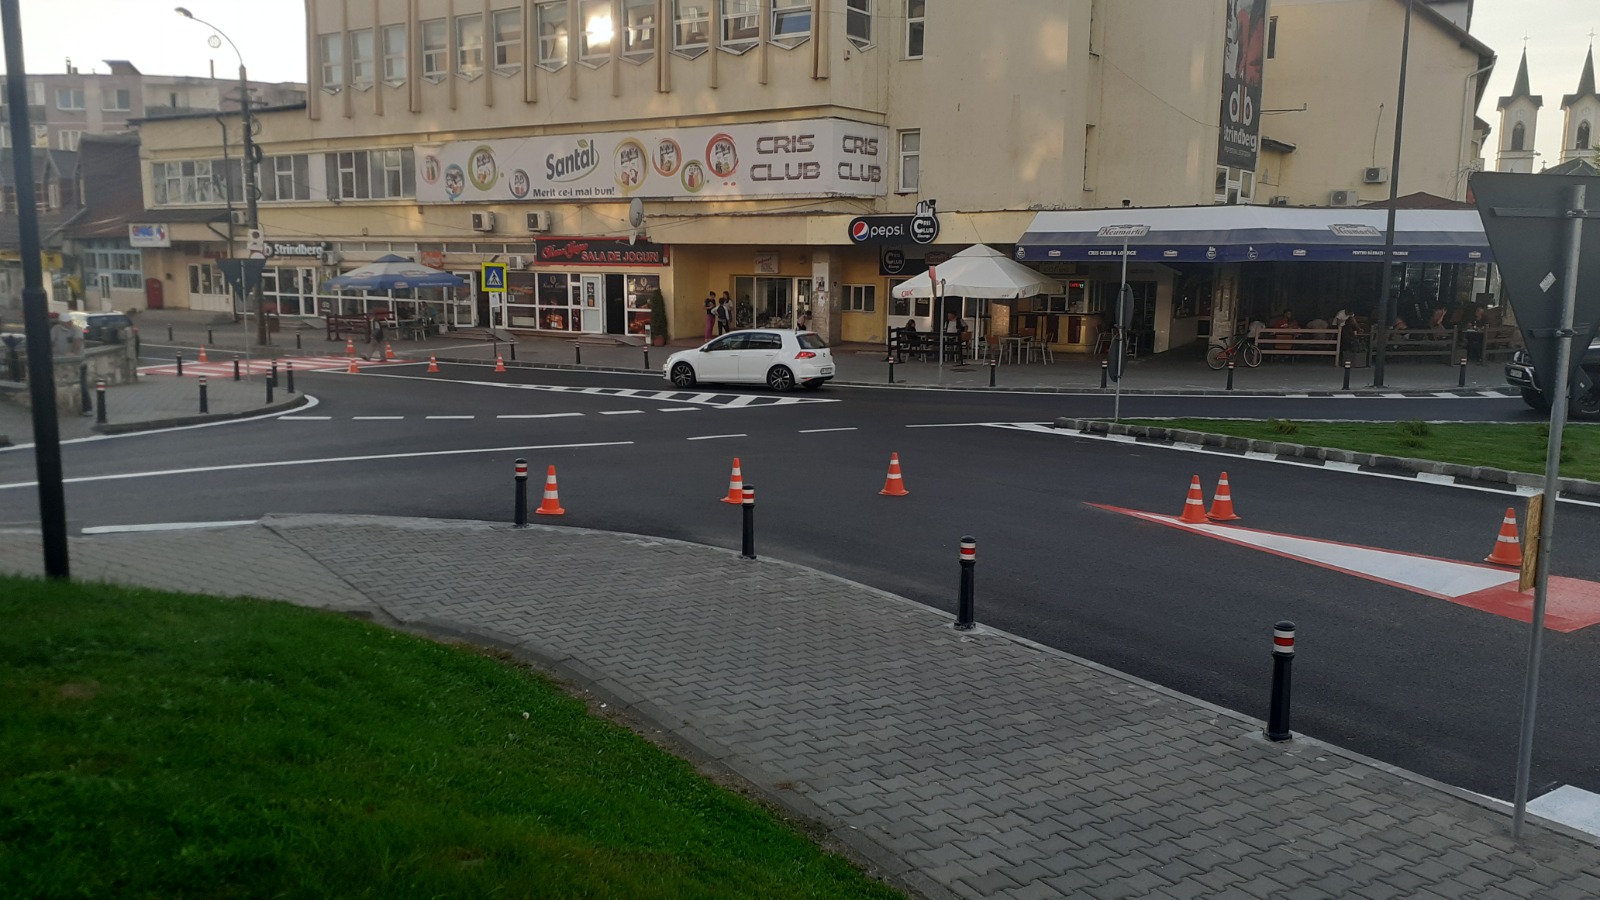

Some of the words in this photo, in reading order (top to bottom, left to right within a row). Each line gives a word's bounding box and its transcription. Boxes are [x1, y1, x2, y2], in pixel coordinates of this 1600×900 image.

[756, 134, 815, 154] CRIS
[842, 135, 878, 156] CRIS
[546, 139, 594, 180] Santal
[750, 161, 820, 181] CLUB
[838, 162, 881, 182] CLUB
[533, 188, 556, 197] Merit
[575, 187, 592, 196] mai
[594, 186, 615, 196] bun!
[871, 224, 903, 238] pepsi
[274, 243, 323, 259] Strindberg
[581, 251, 606, 262] SALA
[607, 251, 622, 261] DE
[623, 251, 659, 262] JOCURI
